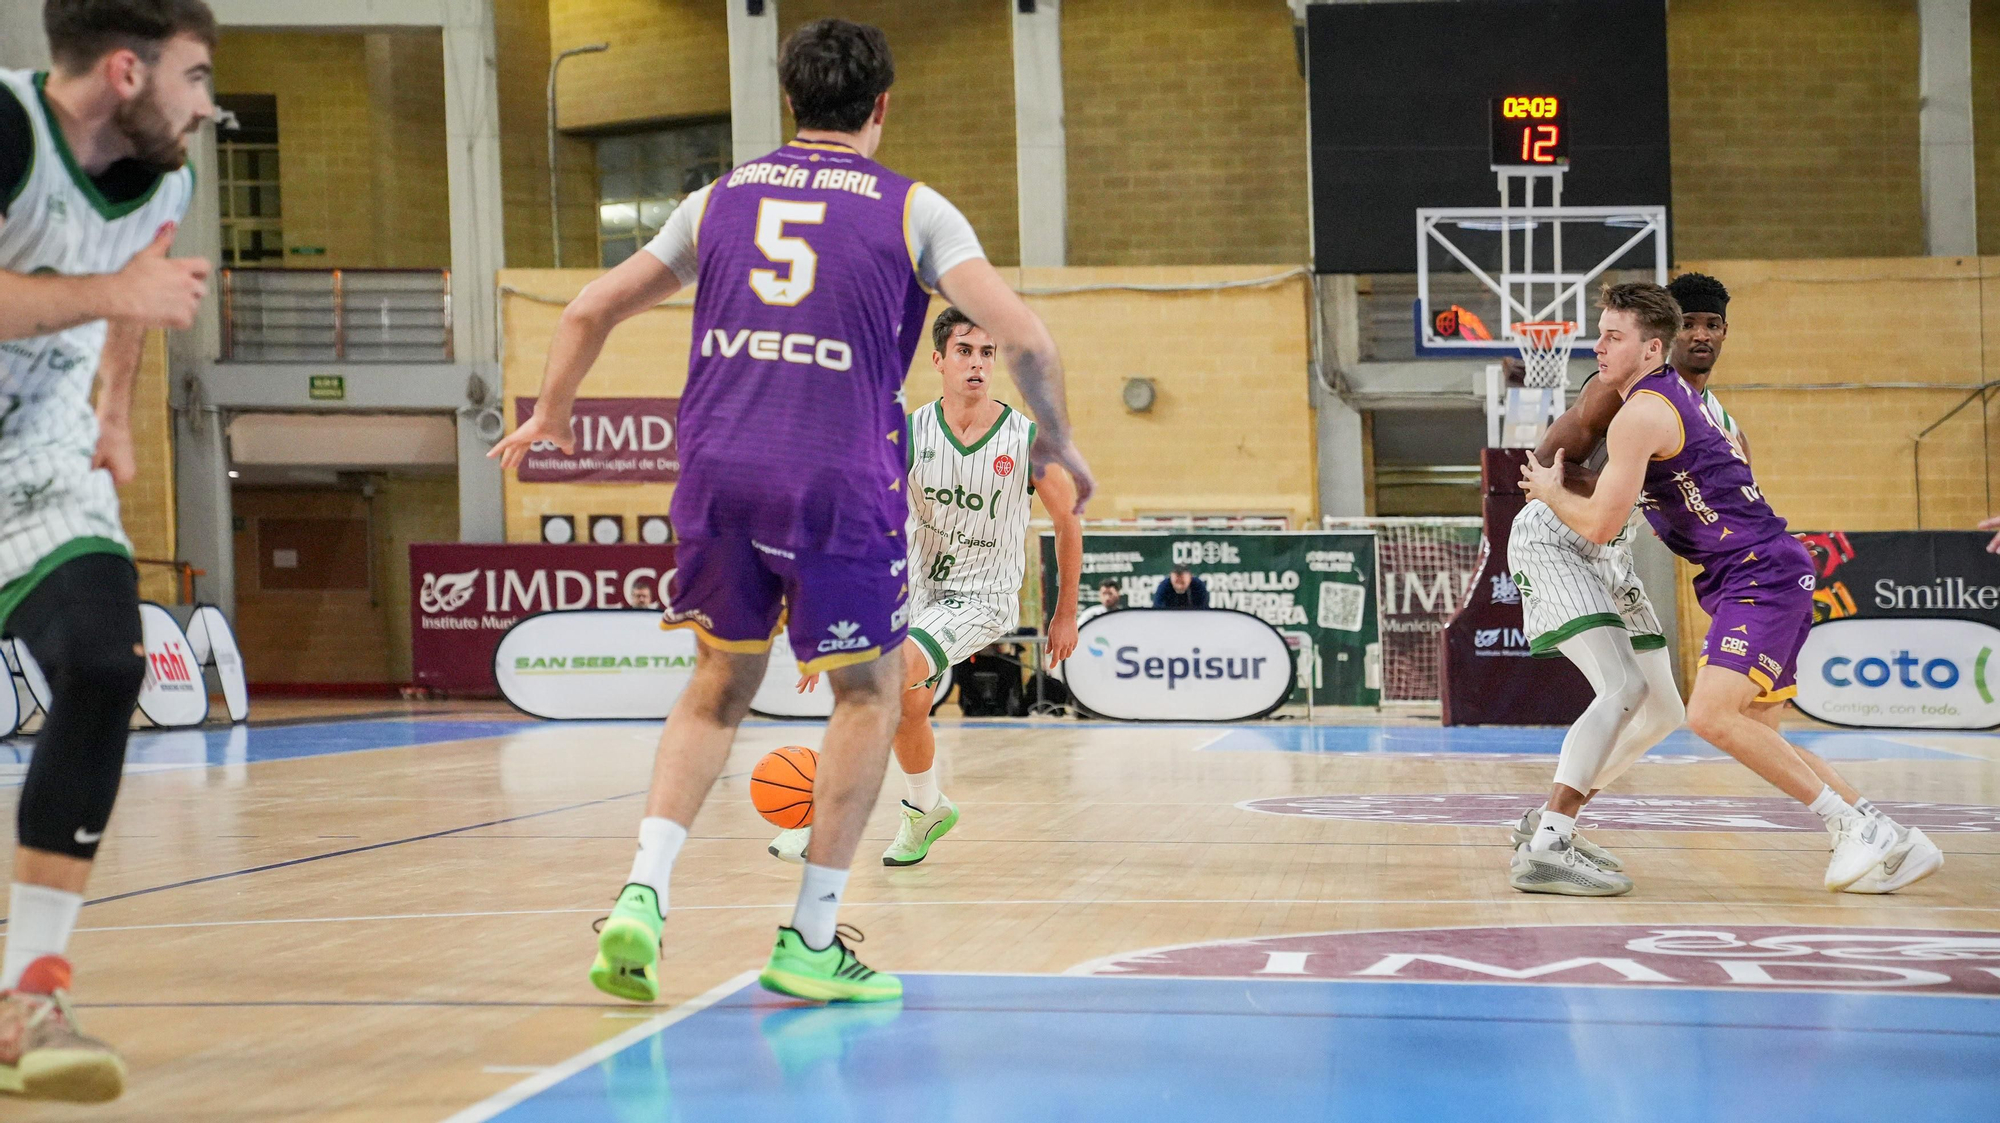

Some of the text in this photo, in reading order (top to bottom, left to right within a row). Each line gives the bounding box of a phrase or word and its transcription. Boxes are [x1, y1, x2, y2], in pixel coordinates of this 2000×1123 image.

[1521, 125, 1558, 162] 12
[727, 162, 882, 200] GARCÍA ABRIL
[749, 197, 827, 306] 5
[701, 328, 853, 372] IVECO
[582, 415, 677, 452] IMD
[528, 458, 576, 470] Instituto
[578, 457, 637, 472] Municipal
[638, 458, 654, 470] de
[957, 531, 997, 548] Cajasol
[928, 551, 955, 582] 16
[1875, 577, 2000, 611] Smilke
[421, 615, 479, 630] Instituto
[1721, 636, 1749, 653] CBC
[515, 657, 567, 668] SAN
[1115, 646, 1266, 690] Sepisur
[1822, 650, 1959, 690] coto
[1822, 703, 1961, 716] Contigo, con todo.
